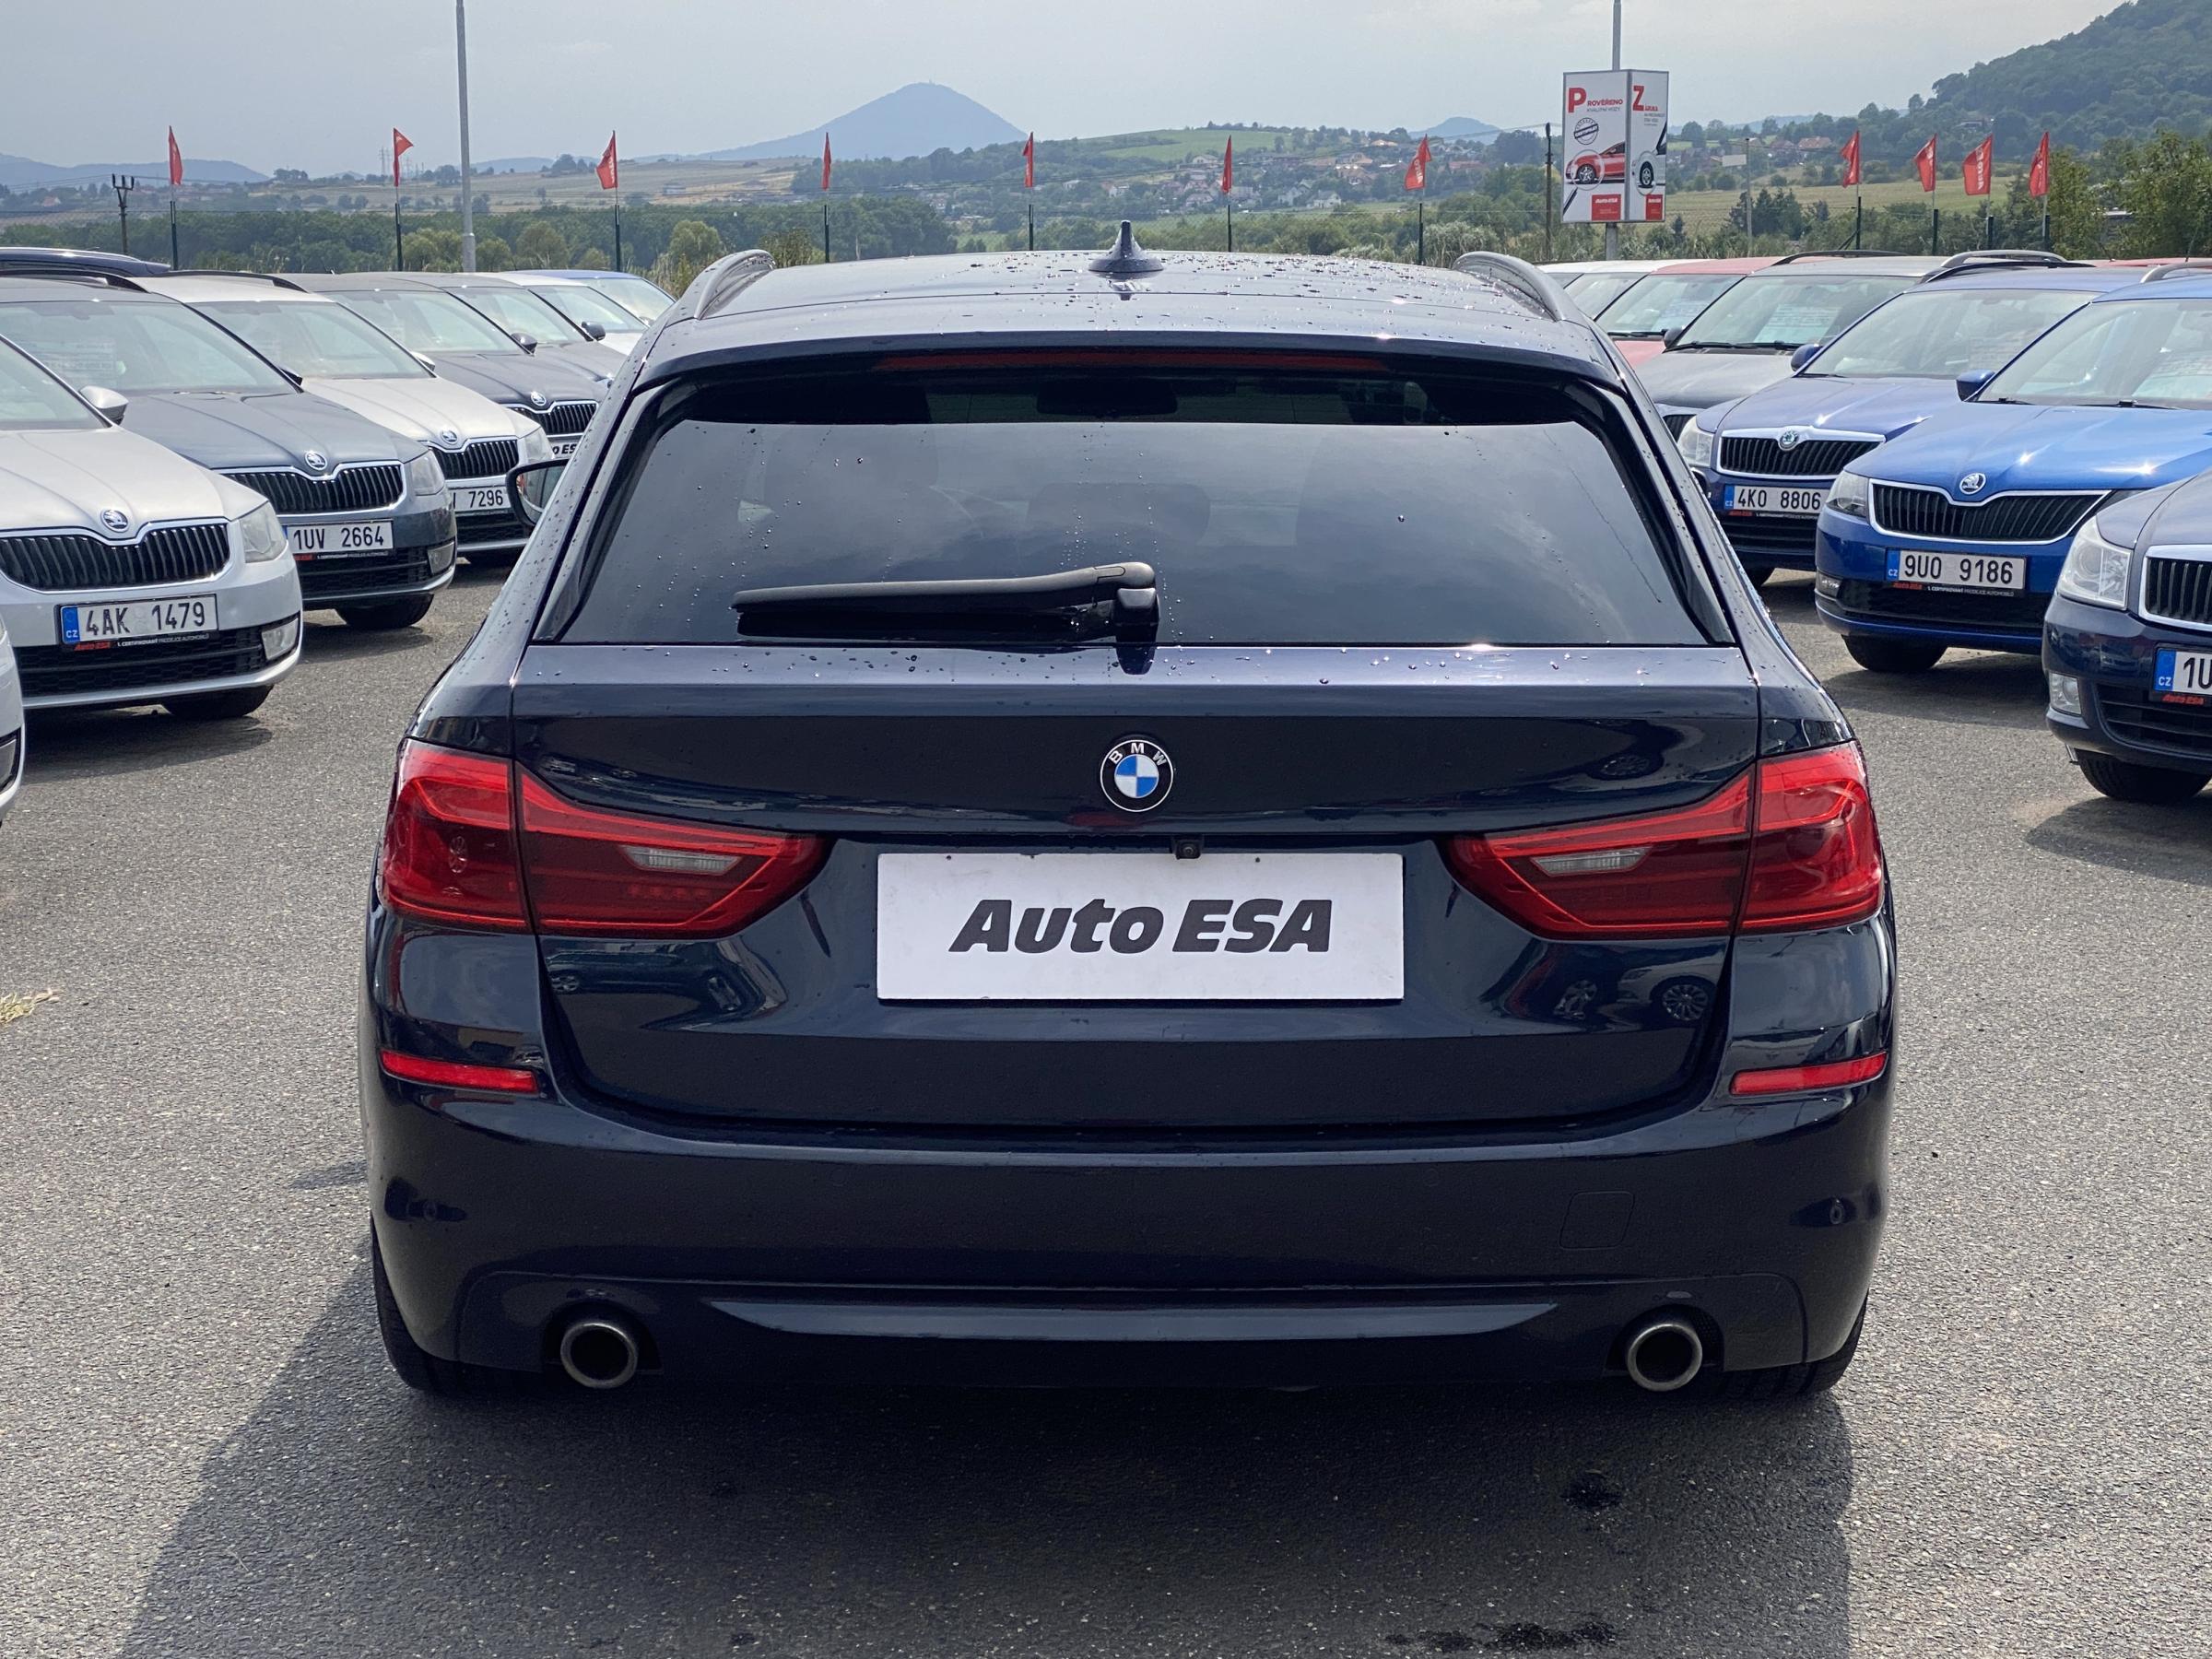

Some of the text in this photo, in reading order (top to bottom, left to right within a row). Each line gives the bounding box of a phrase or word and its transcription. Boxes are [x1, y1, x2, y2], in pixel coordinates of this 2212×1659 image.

[468, 489, 503, 508] 7296
[1780, 490, 1821, 510] 8806
[293, 525, 383, 550] 1UV 2664
[1888, 569, 1898, 577] CZ
[1959, 559, 2013, 584] 9186
[86, 602, 206, 636] 4AK 1479
[65, 629, 78, 639] CZ
[2159, 677, 2171, 686] CZ
[2183, 657, 2212, 689] 1U
[1108, 742, 1167, 766] BMW
[947, 899, 1334, 954] Auto ESA
